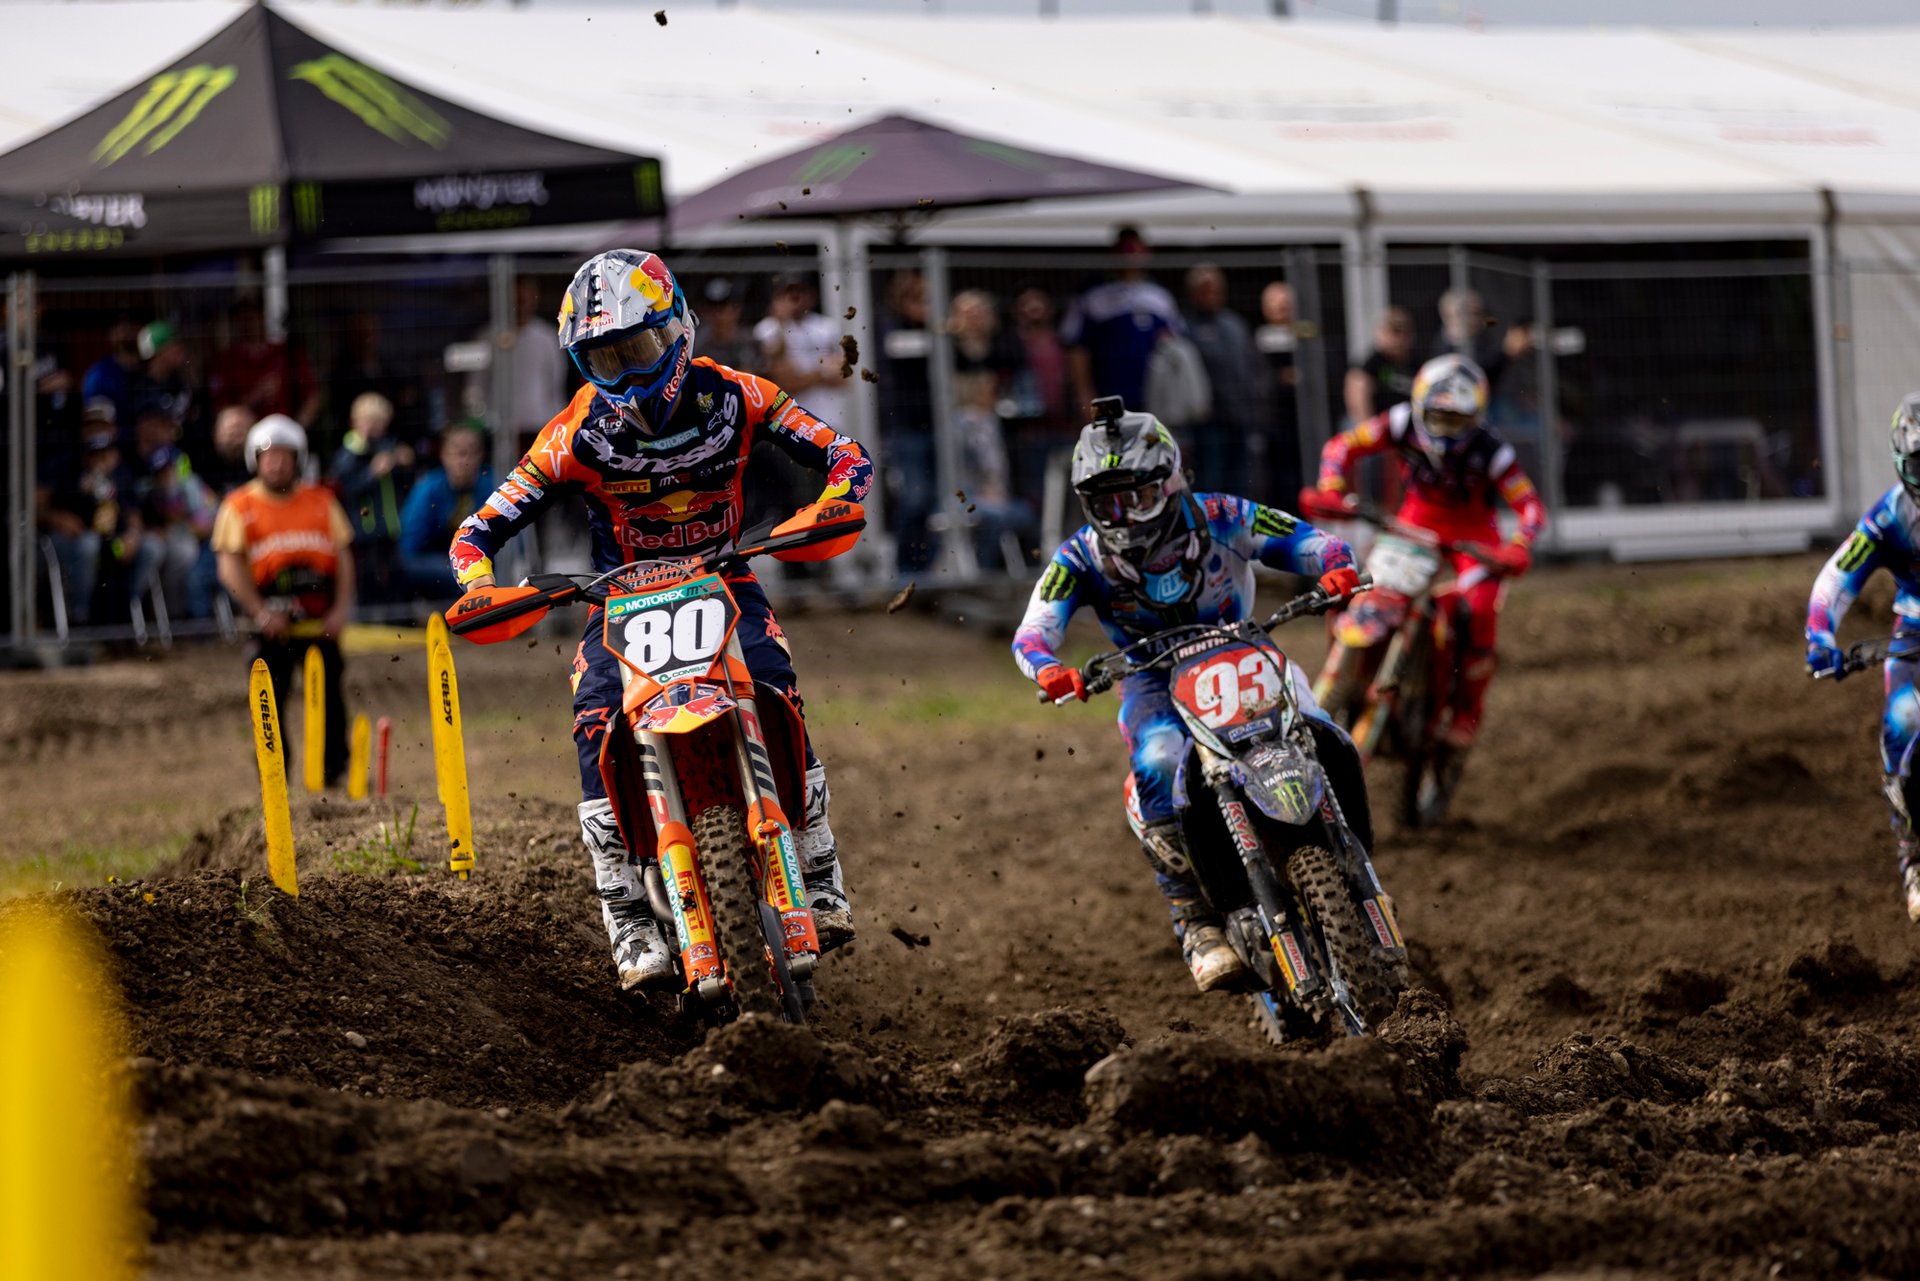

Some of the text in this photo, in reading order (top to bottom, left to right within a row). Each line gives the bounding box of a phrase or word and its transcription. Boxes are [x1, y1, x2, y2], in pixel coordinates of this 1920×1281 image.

[579, 392, 739, 474] apinestas
[621, 501, 739, 549] Red Bull
[816, 503, 852, 523] KTM
[457, 594, 492, 615] KTM
[625, 581, 720, 612] MOTOREX MX2
[624, 598, 726, 674] 80
[440, 670, 454, 726] ACERBIS
[1194, 649, 1283, 730] 93
[259, 688, 275, 753] ACERBIS
[1262, 768, 1302, 788] YAMAHA
[780, 829, 803, 889] MOTOREX
[665, 878, 690, 952] MOTOREX
[677, 870, 705, 931] PILLI
